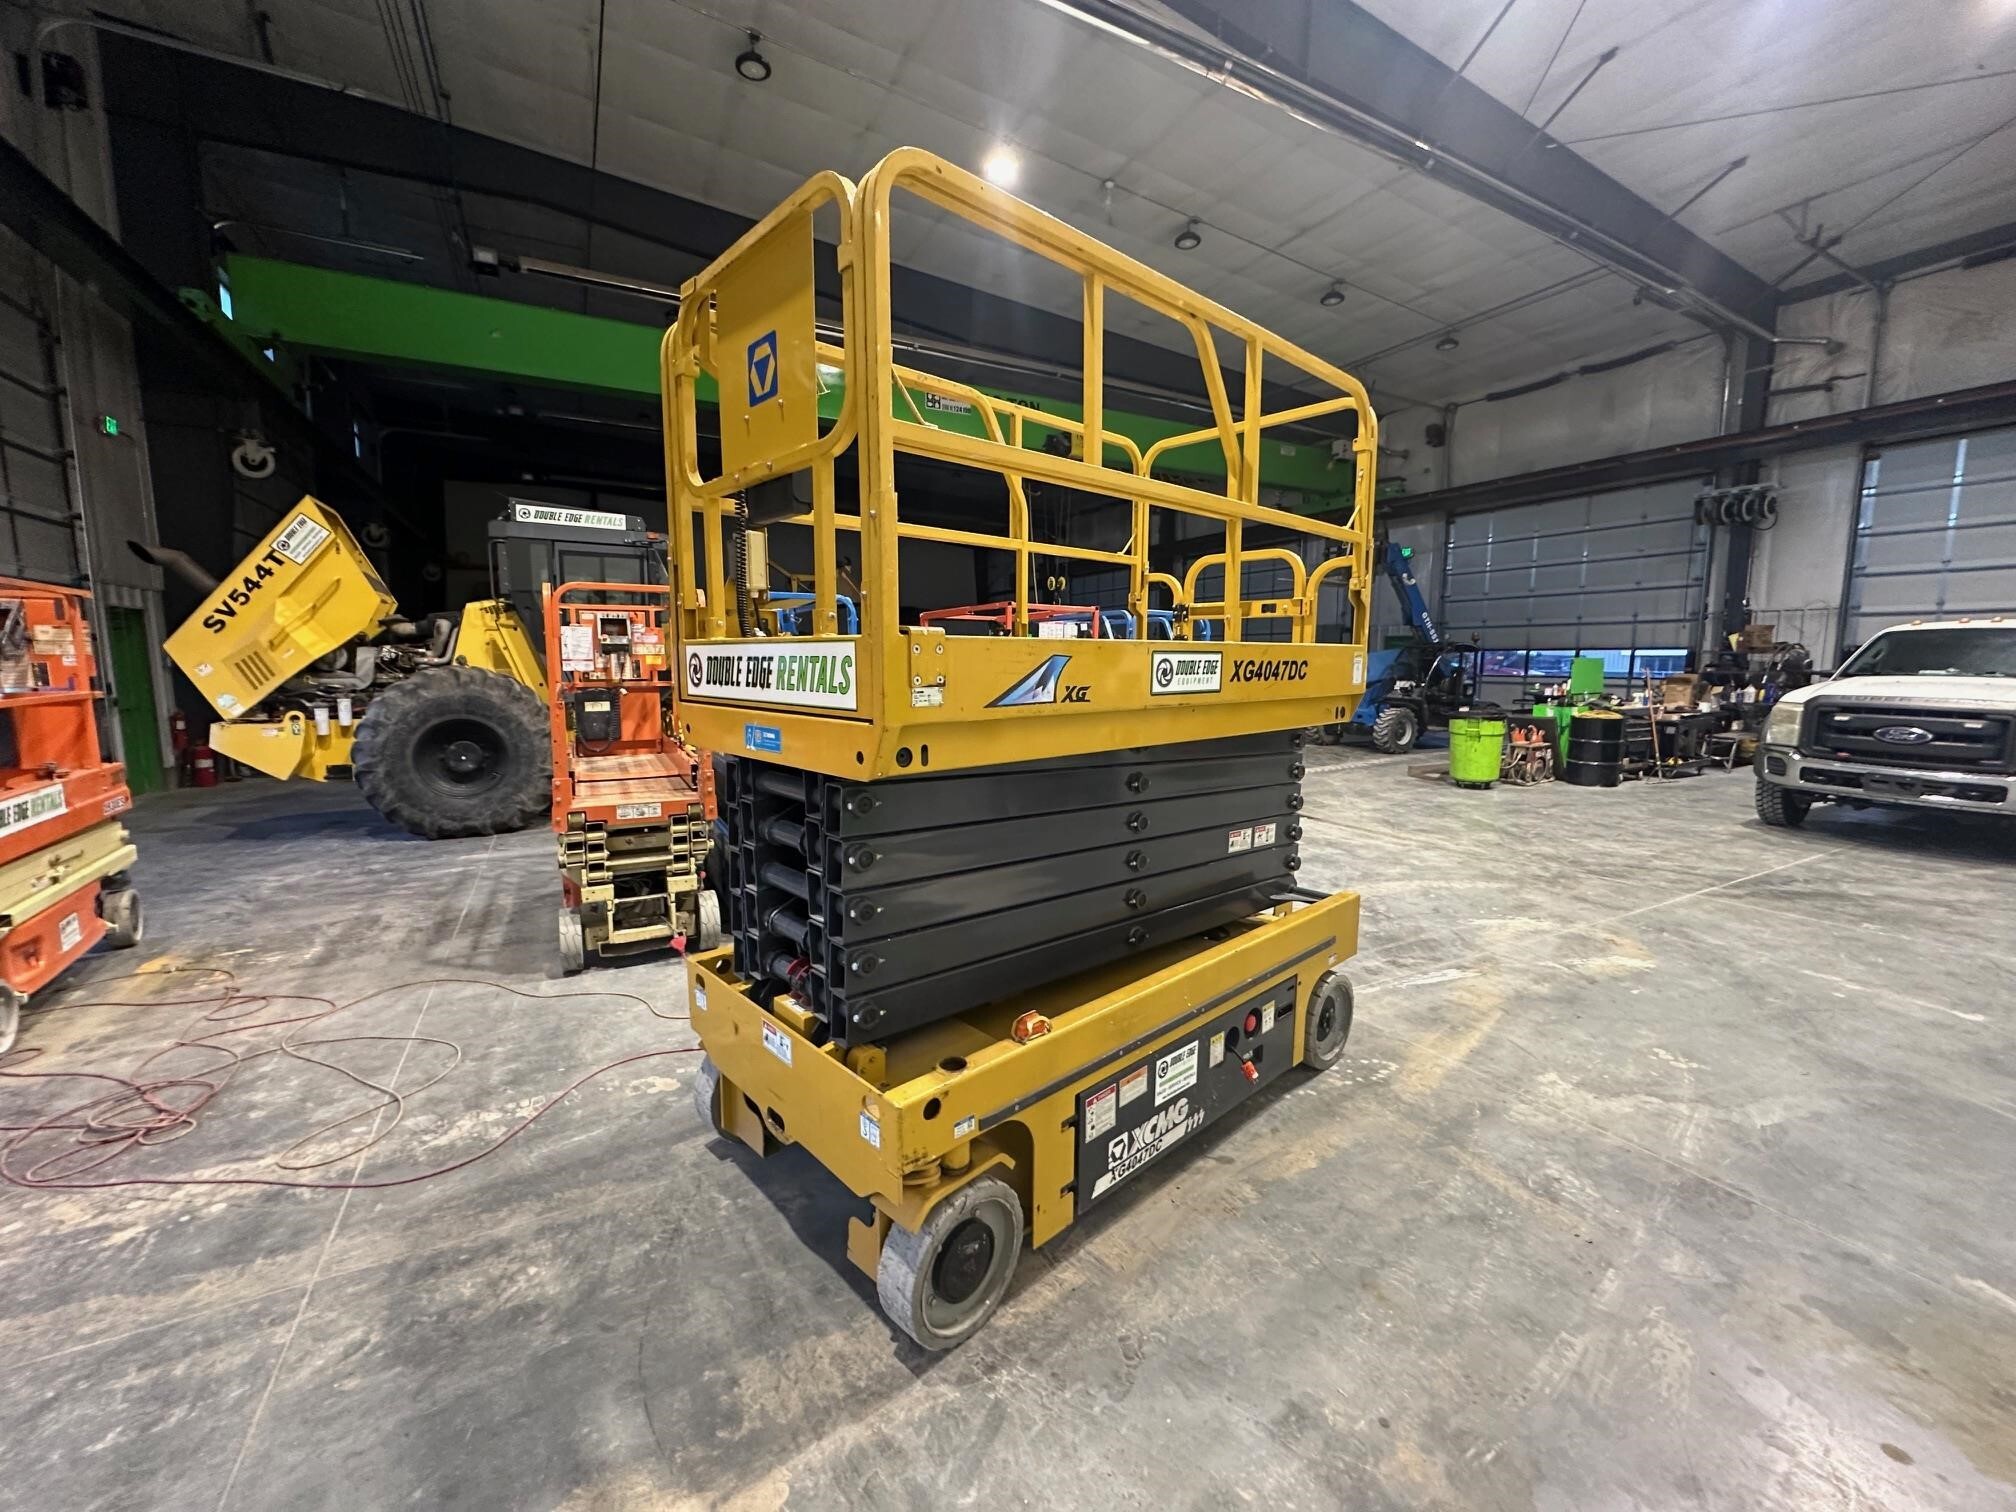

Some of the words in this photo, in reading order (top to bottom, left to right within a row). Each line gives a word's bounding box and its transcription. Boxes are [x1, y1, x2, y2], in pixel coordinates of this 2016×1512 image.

[533, 509, 562, 521] DOUBLE
[564, 512, 583, 523] EDGE
[584, 514, 623, 527] RENTALS
[202, 549, 285, 634] SV544T
[706, 655, 743, 688] DOUBLE
[745, 655, 774, 691] EDGE
[776, 655, 853, 695] RENTALS
[1175, 659, 1203, 676] DOUBLE
[1202, 659, 1219, 675] EDGE
[1229, 659, 1309, 682] XG4047DC
[1177, 676, 1213, 686] EQUIPMENT
[1061, 685, 1092, 703] XG
[1129, 1097, 1189, 1155] XCMG
[1109, 1139, 1163, 1184] XG4047DC
